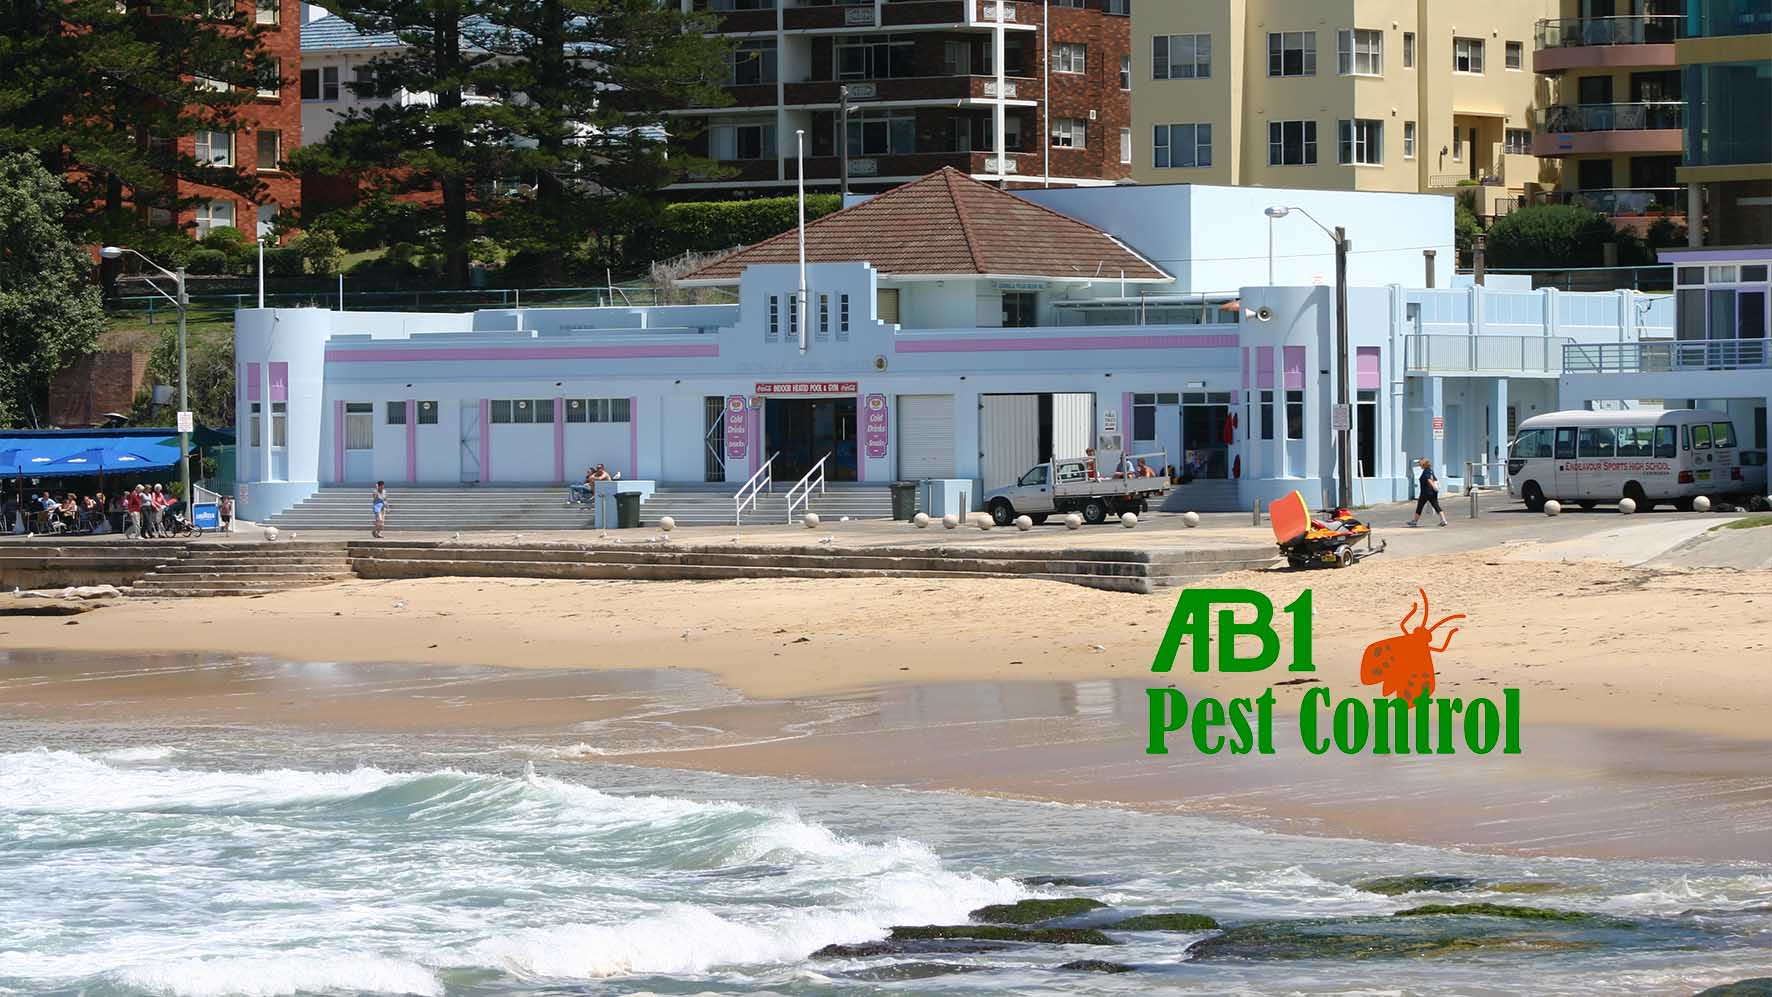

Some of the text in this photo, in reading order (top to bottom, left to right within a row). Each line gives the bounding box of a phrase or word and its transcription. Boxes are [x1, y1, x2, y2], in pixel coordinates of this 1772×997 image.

[792, 384, 809, 392] HEATED
[810, 384, 822, 392] POOL
[730, 415, 743, 424] Cold
[1565, 462, 1671, 471] ENDEAVOUR SPORTS HIGH SCHOOL
